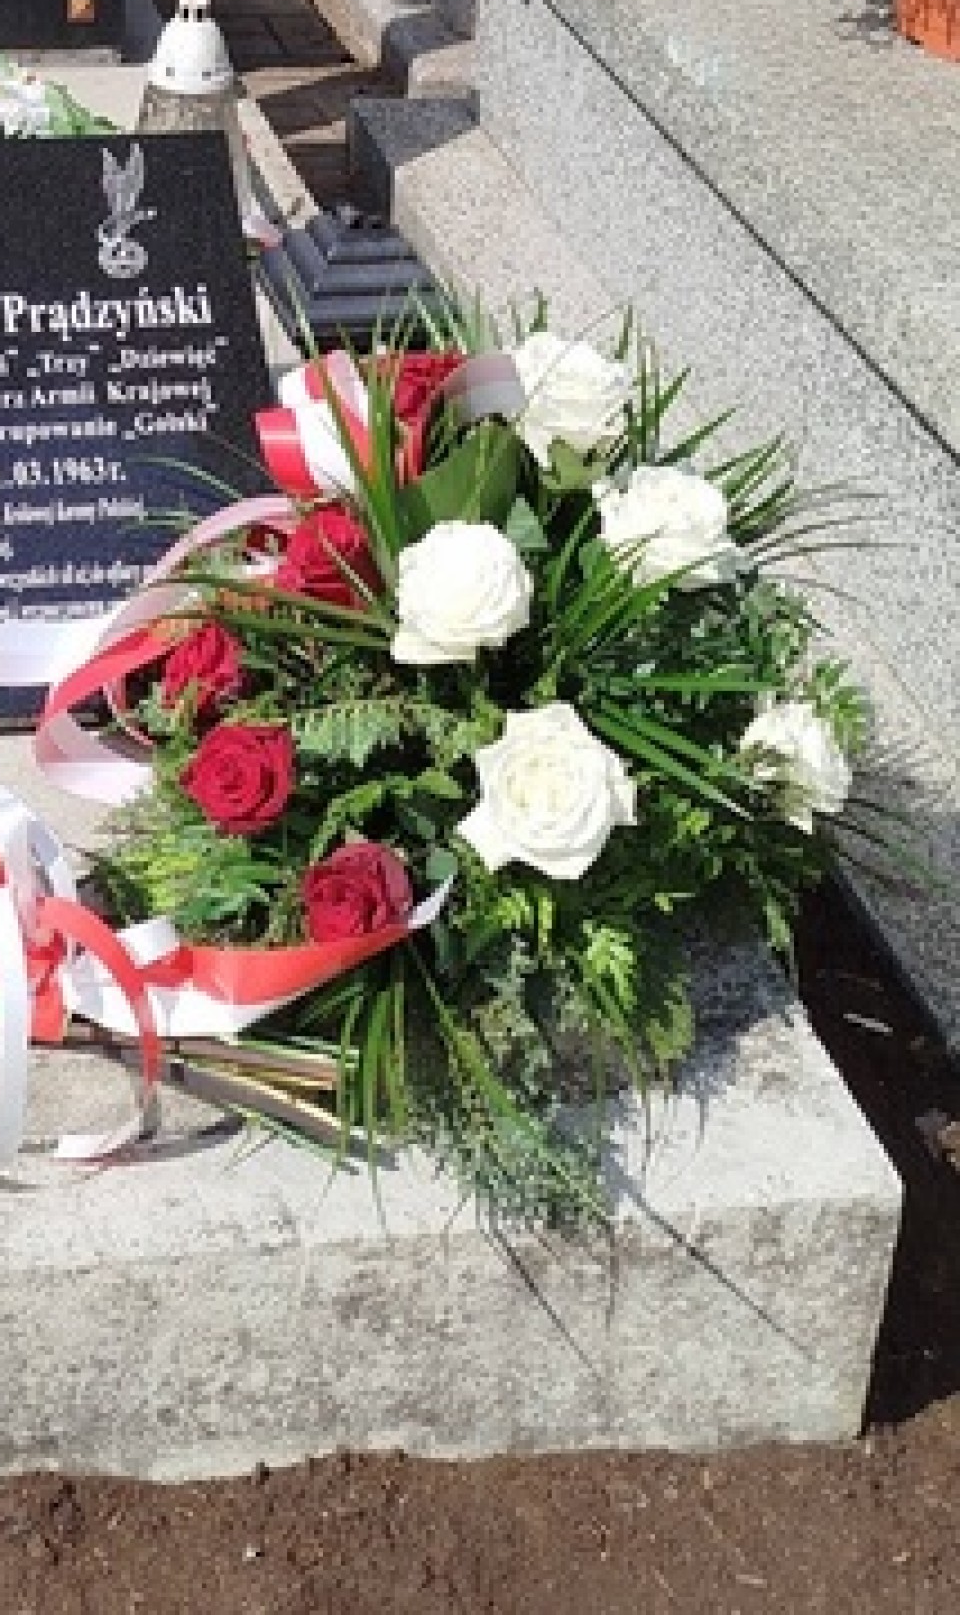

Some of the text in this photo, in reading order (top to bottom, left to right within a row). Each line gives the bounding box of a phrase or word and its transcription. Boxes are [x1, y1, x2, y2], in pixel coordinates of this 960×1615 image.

[1, 283, 213, 343] Prądzyński
[30, 382, 96, 407] Armii
[106, 376, 212, 405] Krajowej
